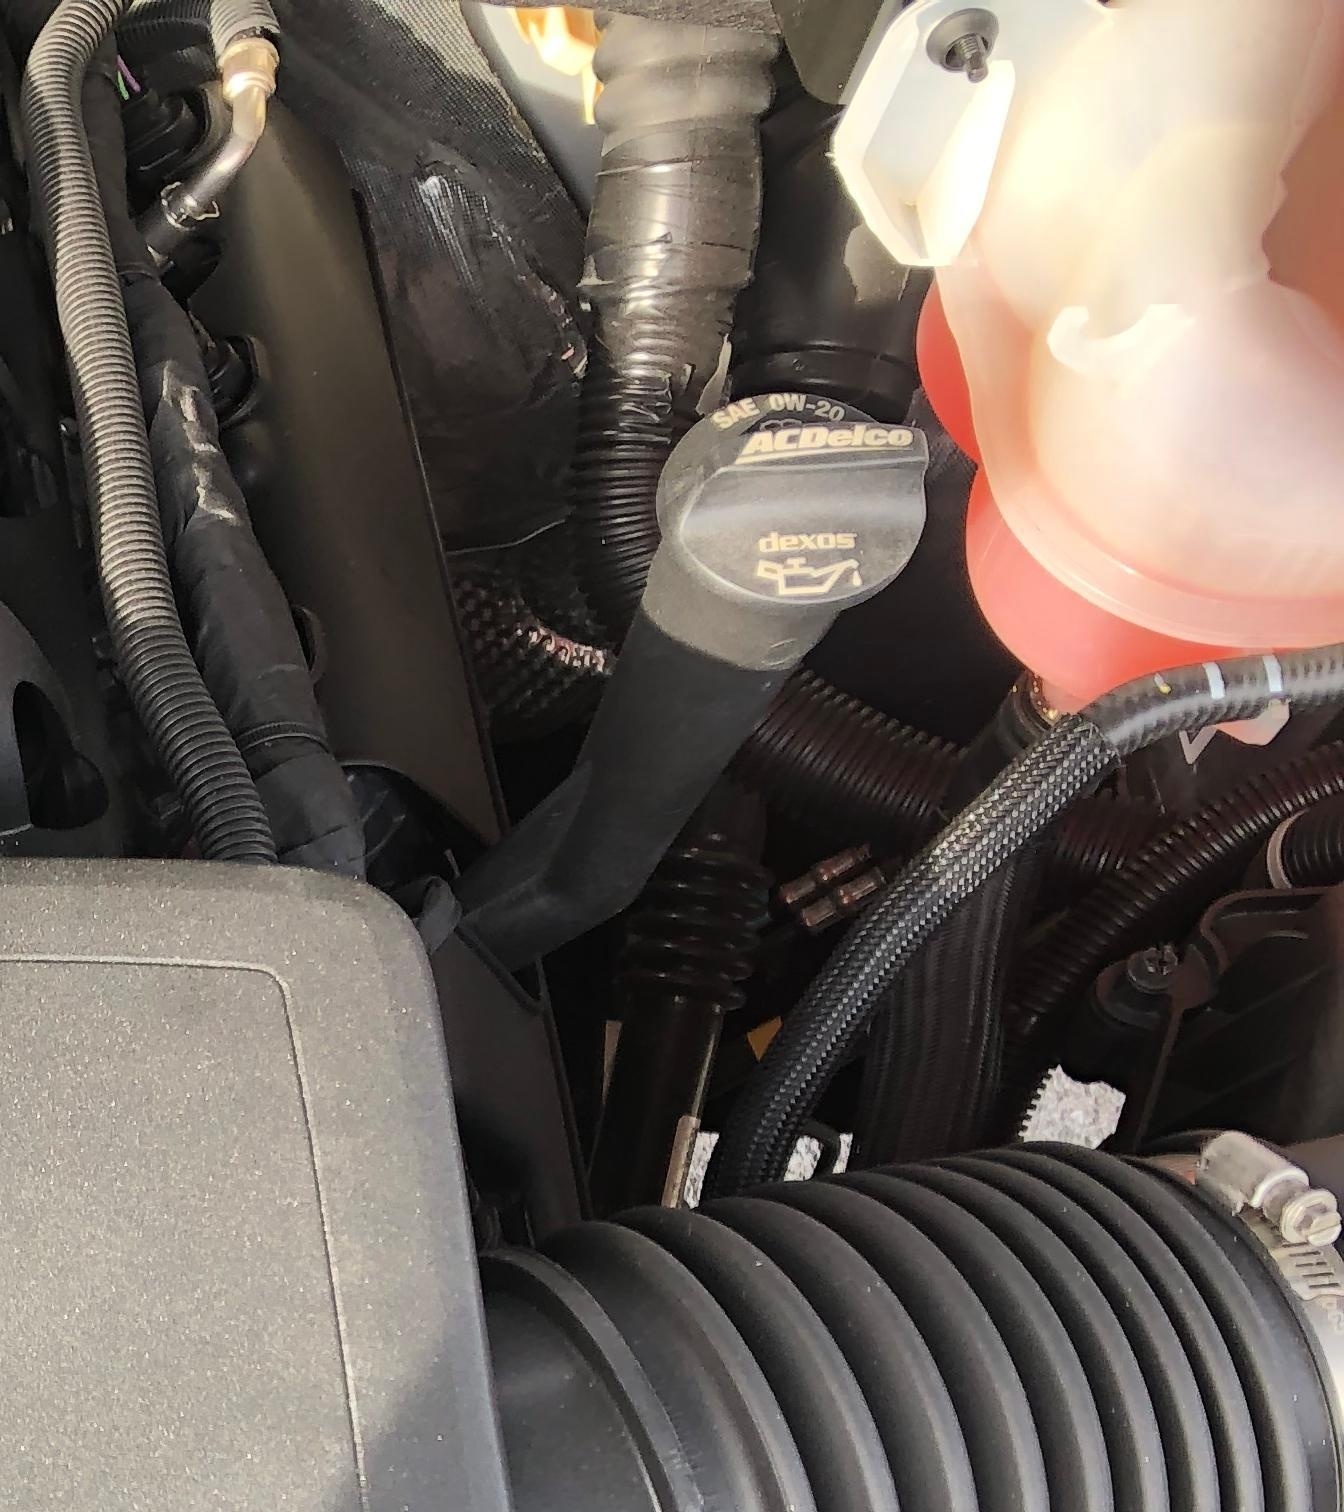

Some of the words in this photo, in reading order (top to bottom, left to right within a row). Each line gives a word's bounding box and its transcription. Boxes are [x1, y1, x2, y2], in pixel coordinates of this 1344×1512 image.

[712, 397, 761, 430] SAE
[769, 393, 845, 422] 0W-20
[741, 424, 914, 455] ACDelco
[758, 531, 857, 552] dexos
